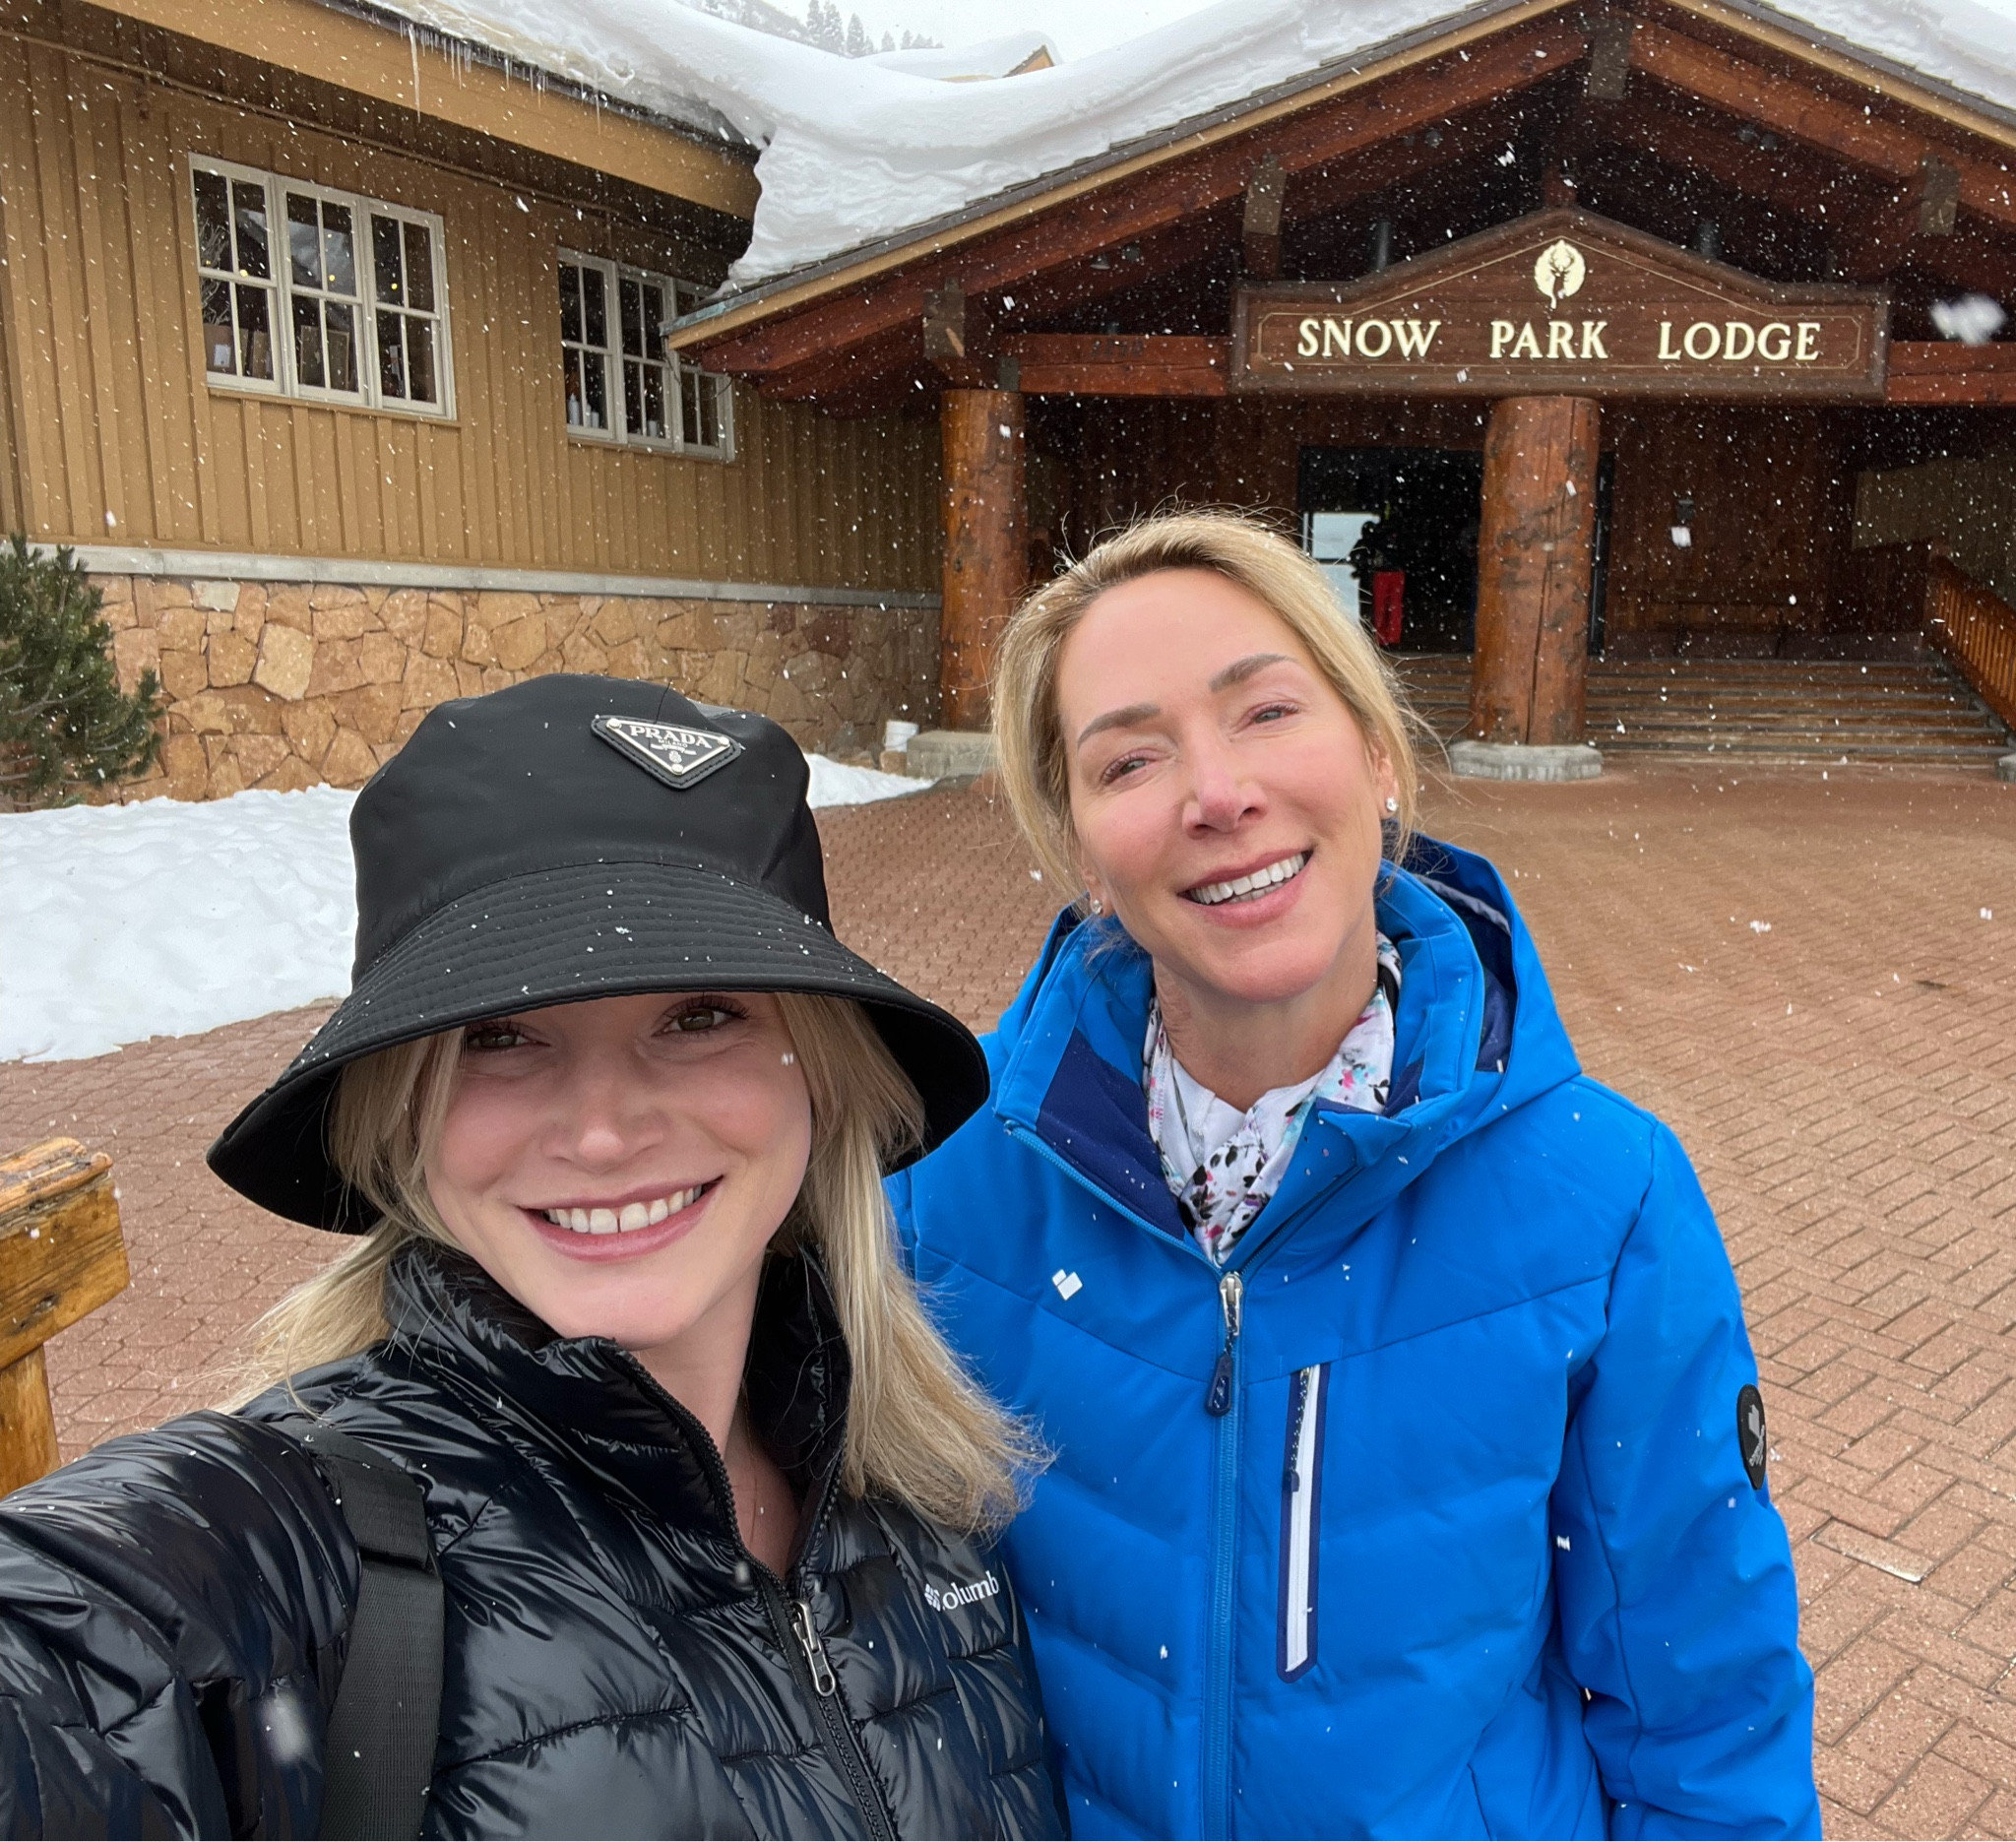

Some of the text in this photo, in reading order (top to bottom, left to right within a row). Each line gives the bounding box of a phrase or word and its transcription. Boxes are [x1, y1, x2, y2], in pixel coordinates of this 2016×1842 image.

[1297, 318, 1821, 362] SNOW PARK LODGE
[629, 725, 713, 749] PRADA
[942, 1569, 999, 1611] olumb
